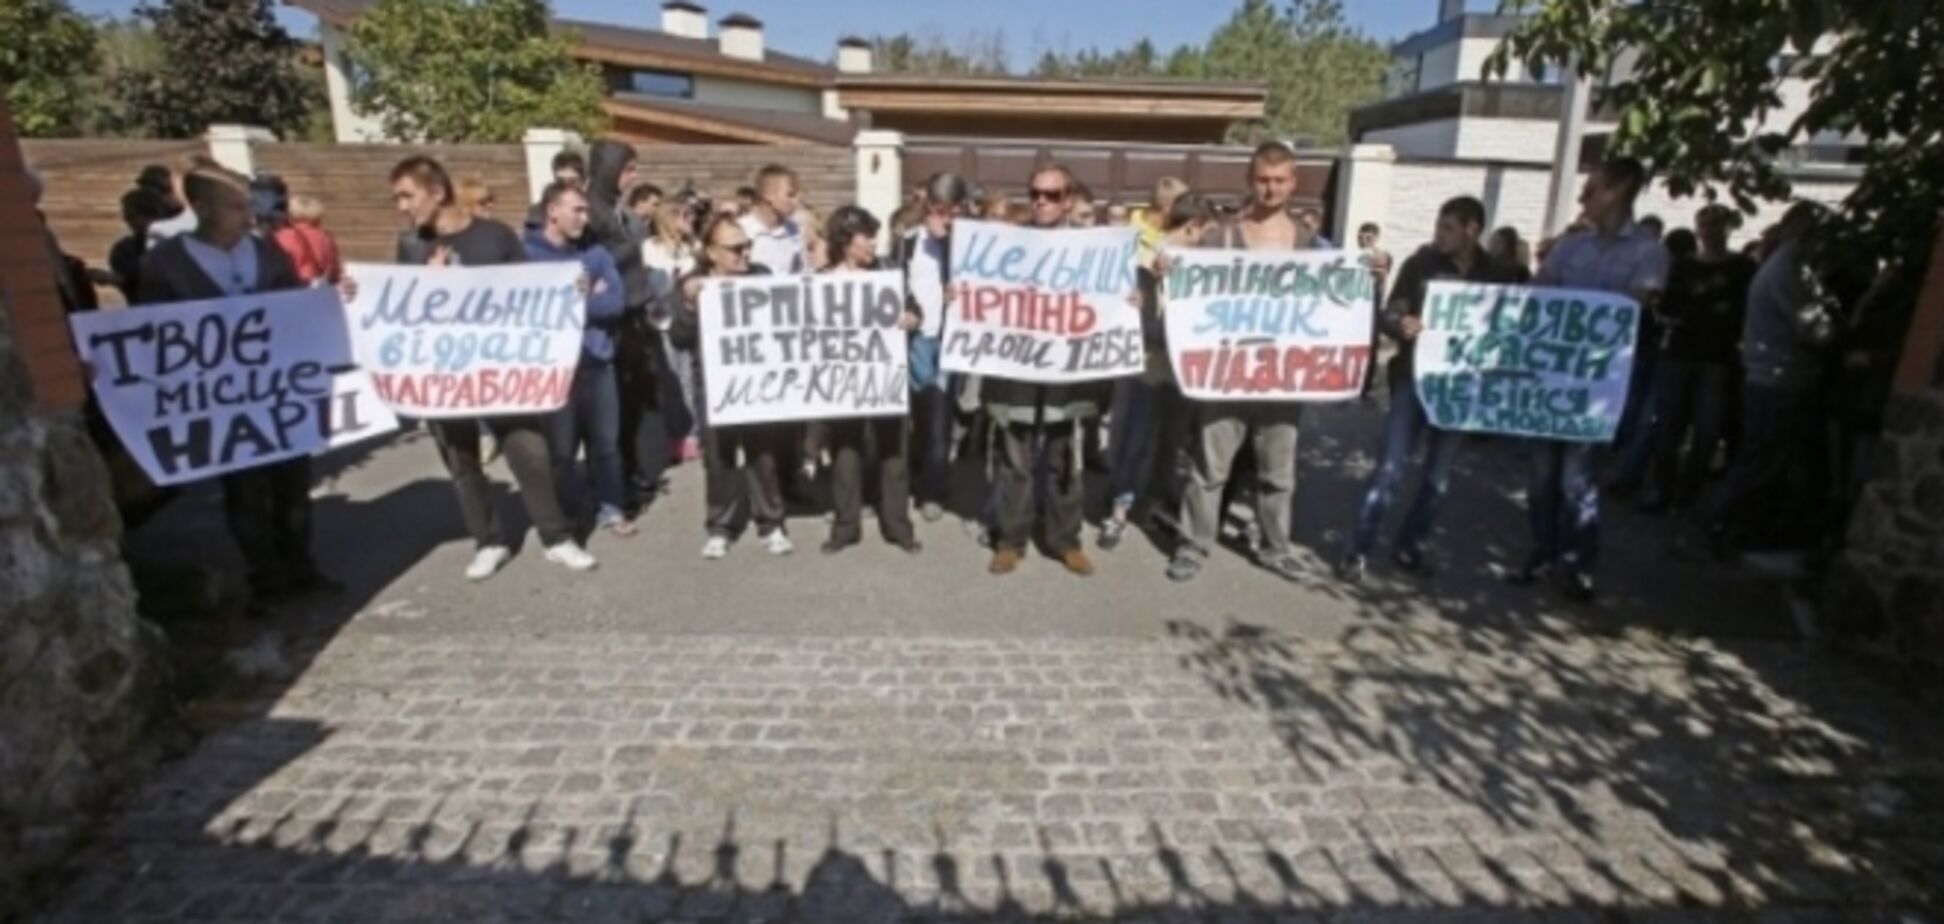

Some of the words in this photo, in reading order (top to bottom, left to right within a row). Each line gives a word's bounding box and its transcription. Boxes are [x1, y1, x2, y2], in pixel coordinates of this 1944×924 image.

[960, 283, 1098, 336] ІРПІНЬ
[91, 308, 272, 386] ТВОЄ
[719, 333, 765, 366] НЕ
[773, 326, 893, 364] ТРЕБА
